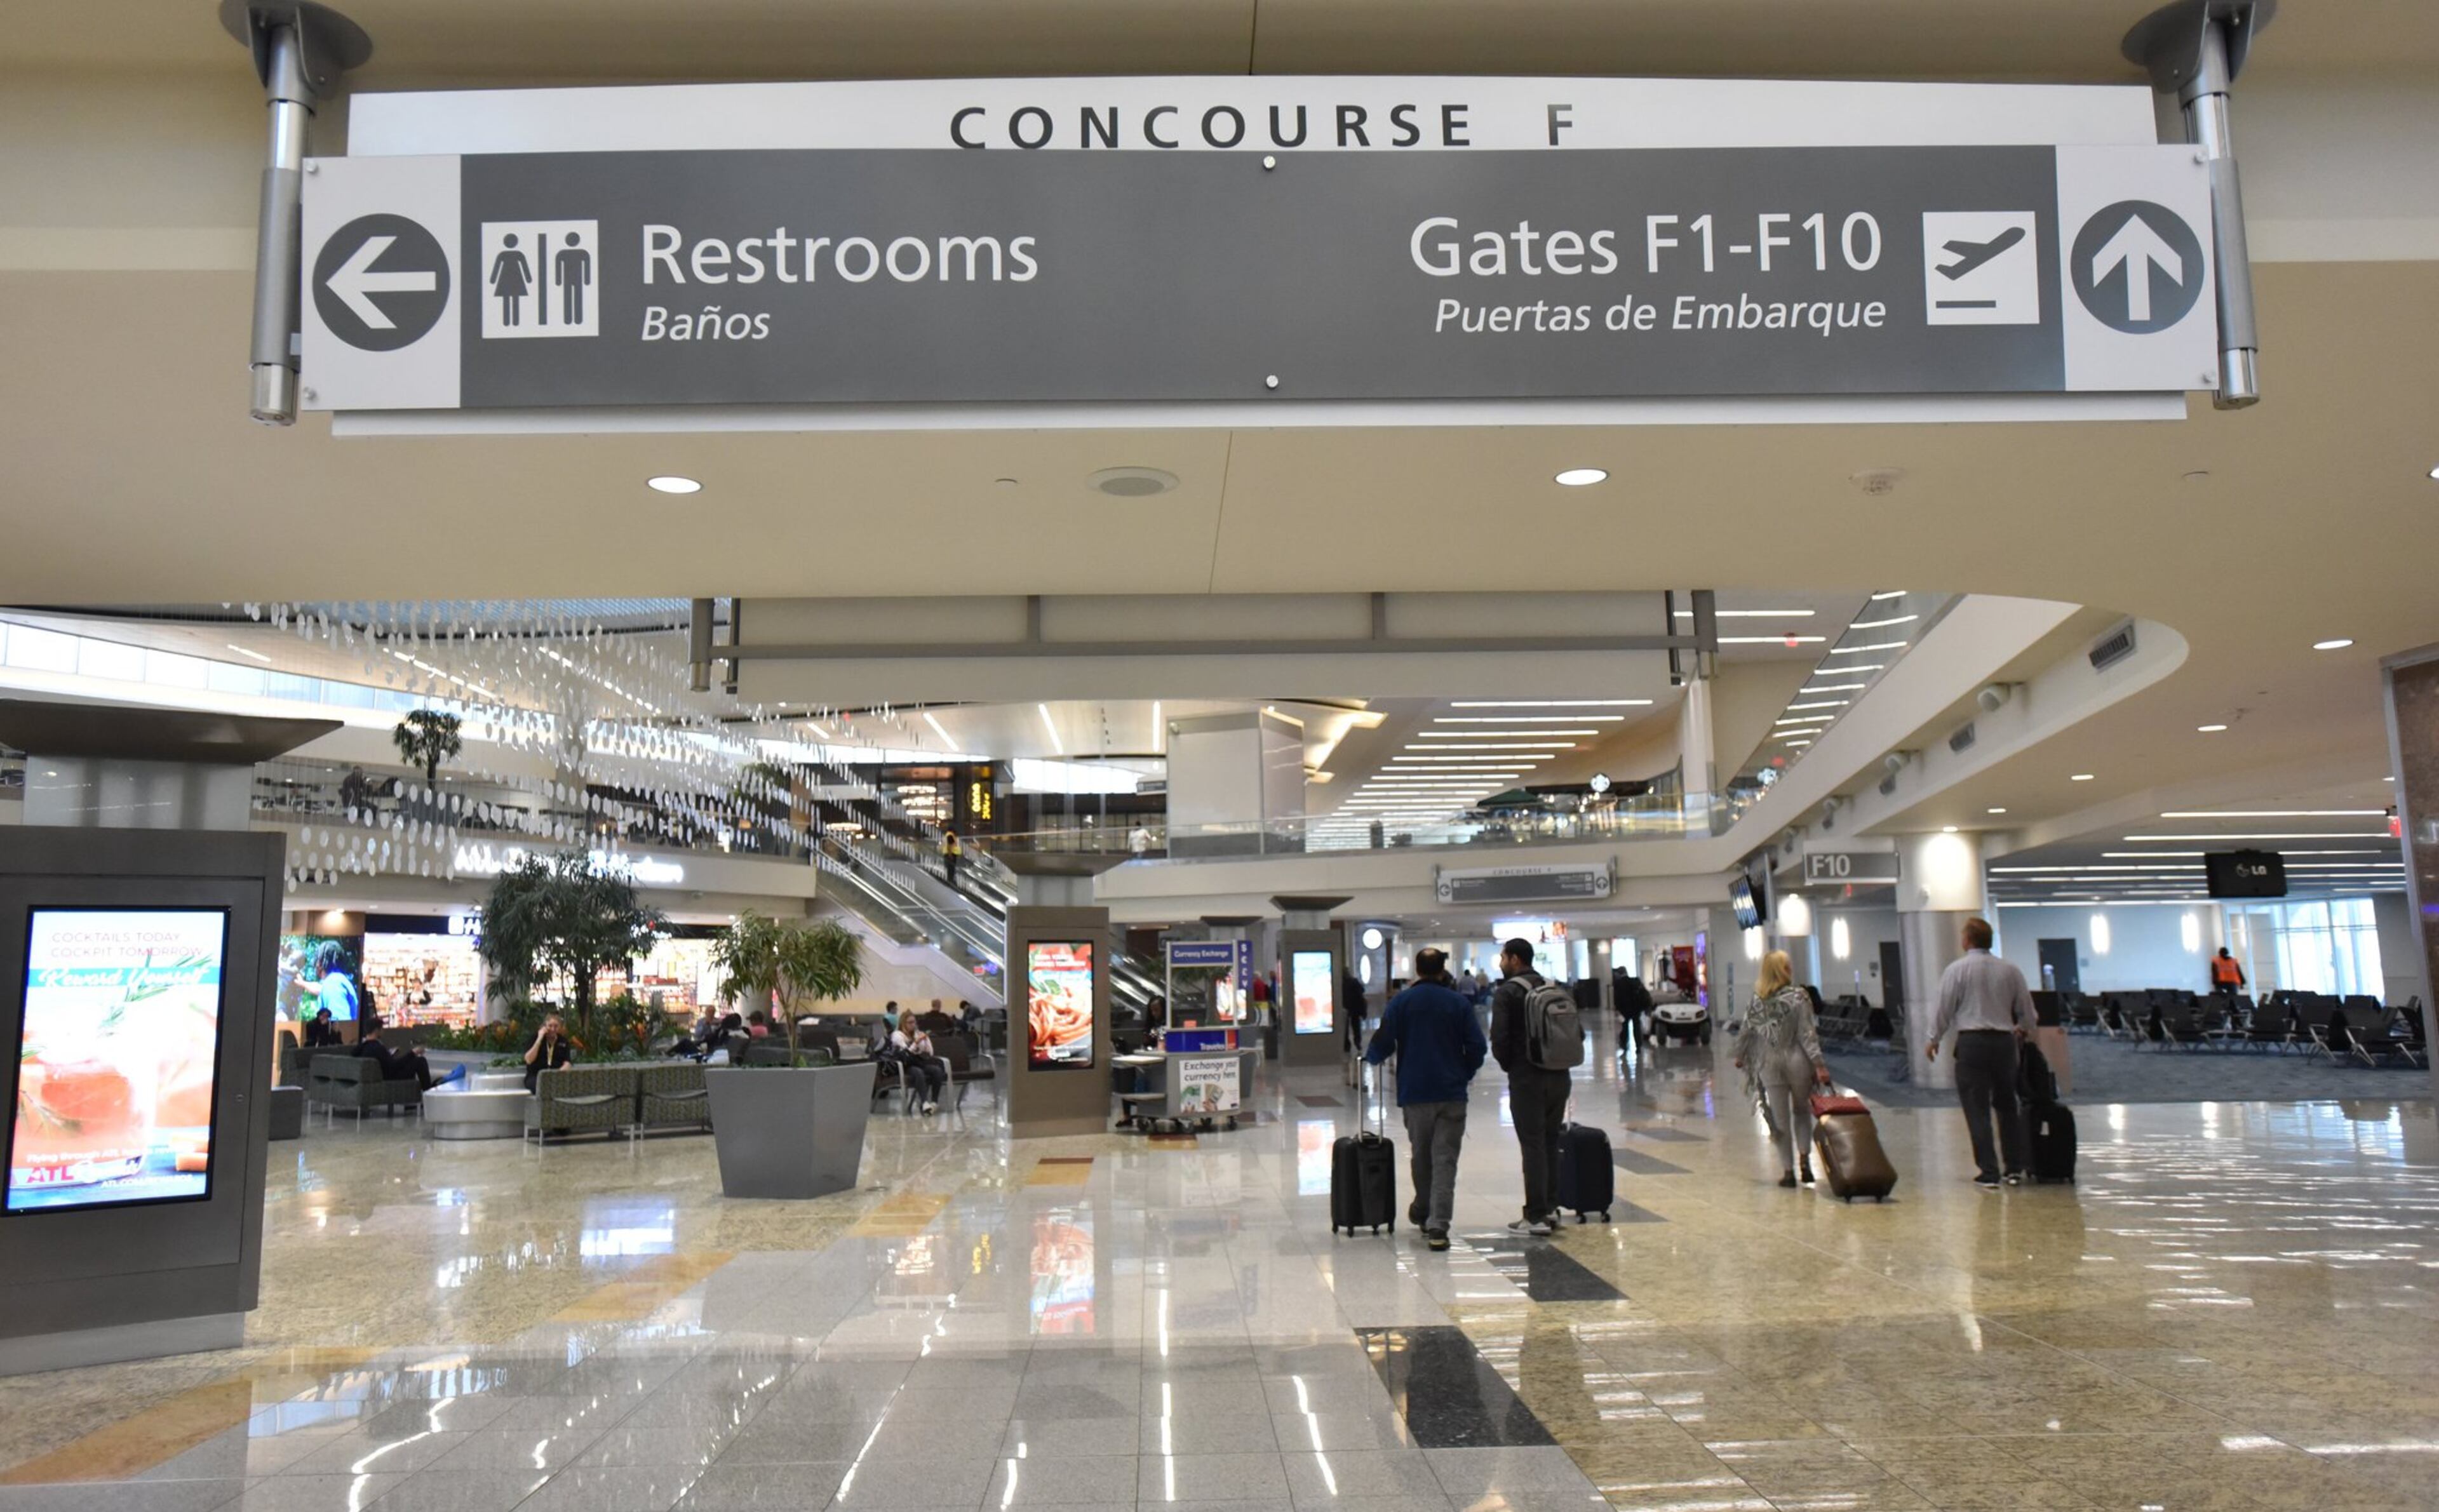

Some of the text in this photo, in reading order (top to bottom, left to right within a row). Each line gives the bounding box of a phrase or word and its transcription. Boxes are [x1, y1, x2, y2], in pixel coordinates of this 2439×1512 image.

[950, 104, 1574, 149] CONCOURSE F
[1410, 211, 1882, 276] Gates F1-F10
[643, 224, 1038, 284] Restrooms
[642, 305, 770, 340] Baños
[1435, 293, 1886, 337] Puertas de Embarque
[1812, 855, 1850, 876] F10
[2250, 866, 2268, 876] LG
[51, 932, 181, 943] COCKTAILS TODAY
[50, 946, 203, 958] COCKPIT TOMORROW
[1174, 949, 1229, 959] Currency Exchange
[1184, 1061, 1224, 1072] Exchange
[1184, 1073, 1221, 1081] currency
[27, 1165, 74, 1183] ATL
